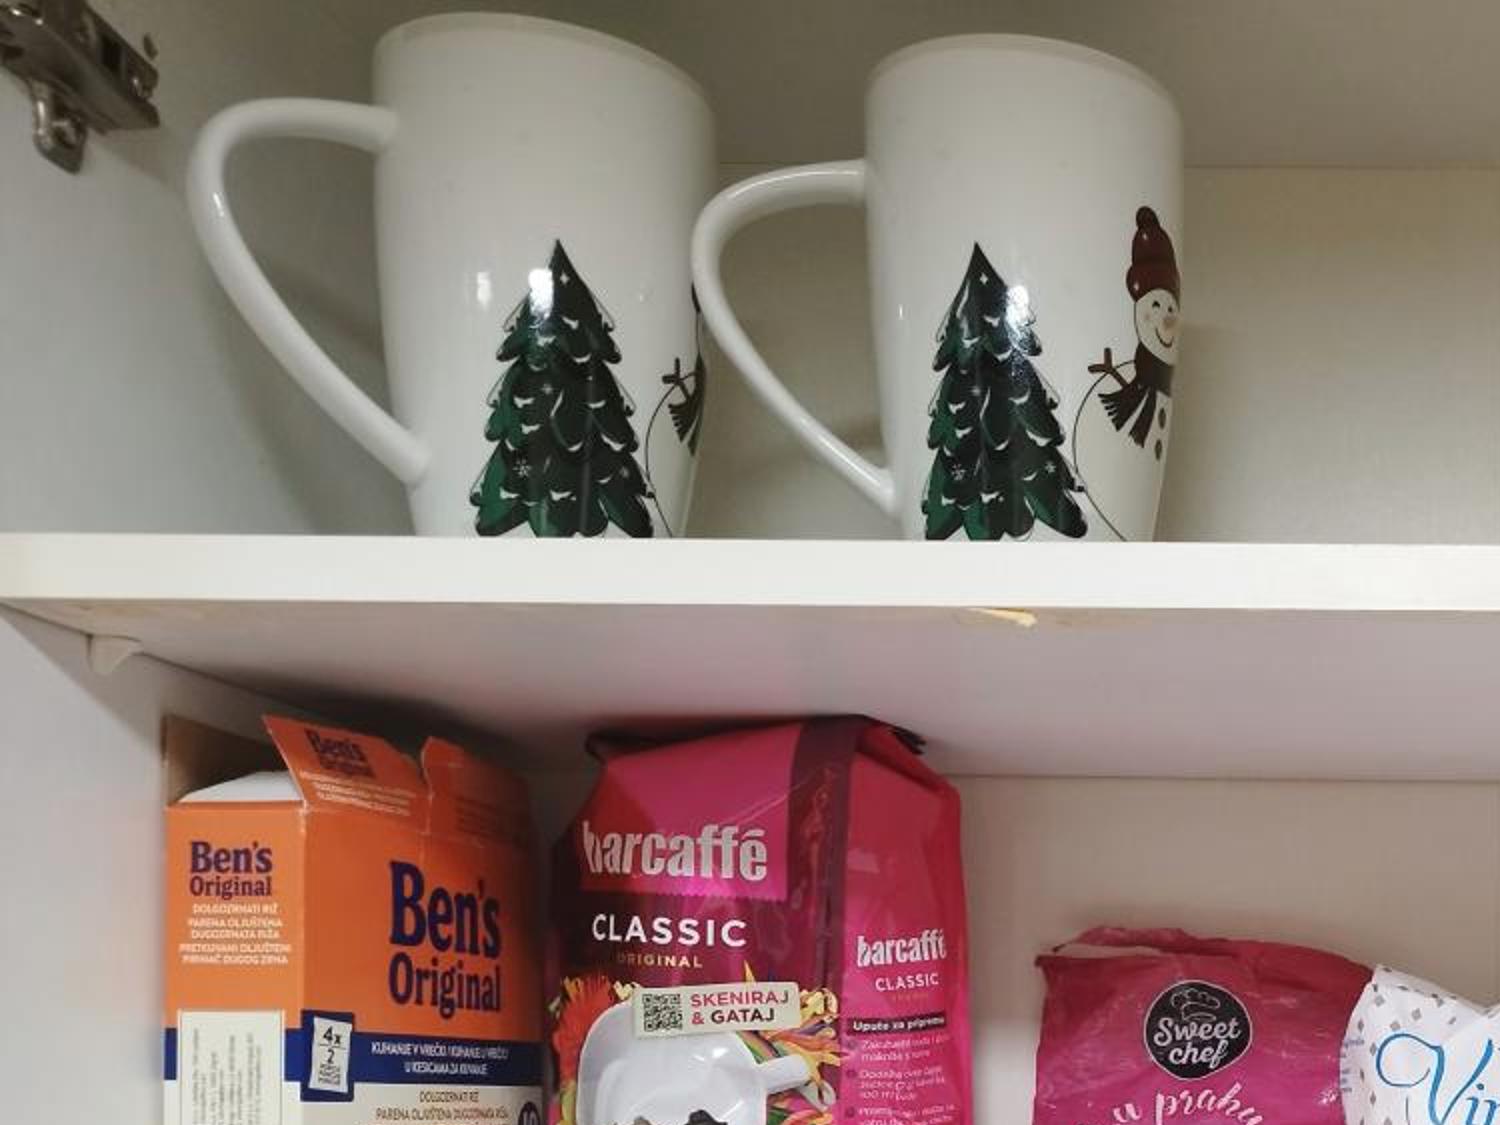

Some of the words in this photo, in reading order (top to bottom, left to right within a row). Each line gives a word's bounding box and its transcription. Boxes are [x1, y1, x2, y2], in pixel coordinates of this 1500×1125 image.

[190, 841, 272, 873] Ben's
[582, 820, 768, 882] barcaffé
[190, 876, 272, 900] Original
[389, 859, 502, 959] Ben's
[592, 913, 748, 948] CLASSIC
[389, 952, 501, 1019] Original
[875, 972, 940, 992] CLASSIC
[689, 991, 789, 1008] SKENIRAJ
[691, 1012, 705, 1025] &
[711, 1008, 775, 1024] GATAJ
[1152, 1015, 1242, 1047] Sweet
[327, 1049, 335, 1064] 2
[1168, 1041, 1230, 1070] chef
